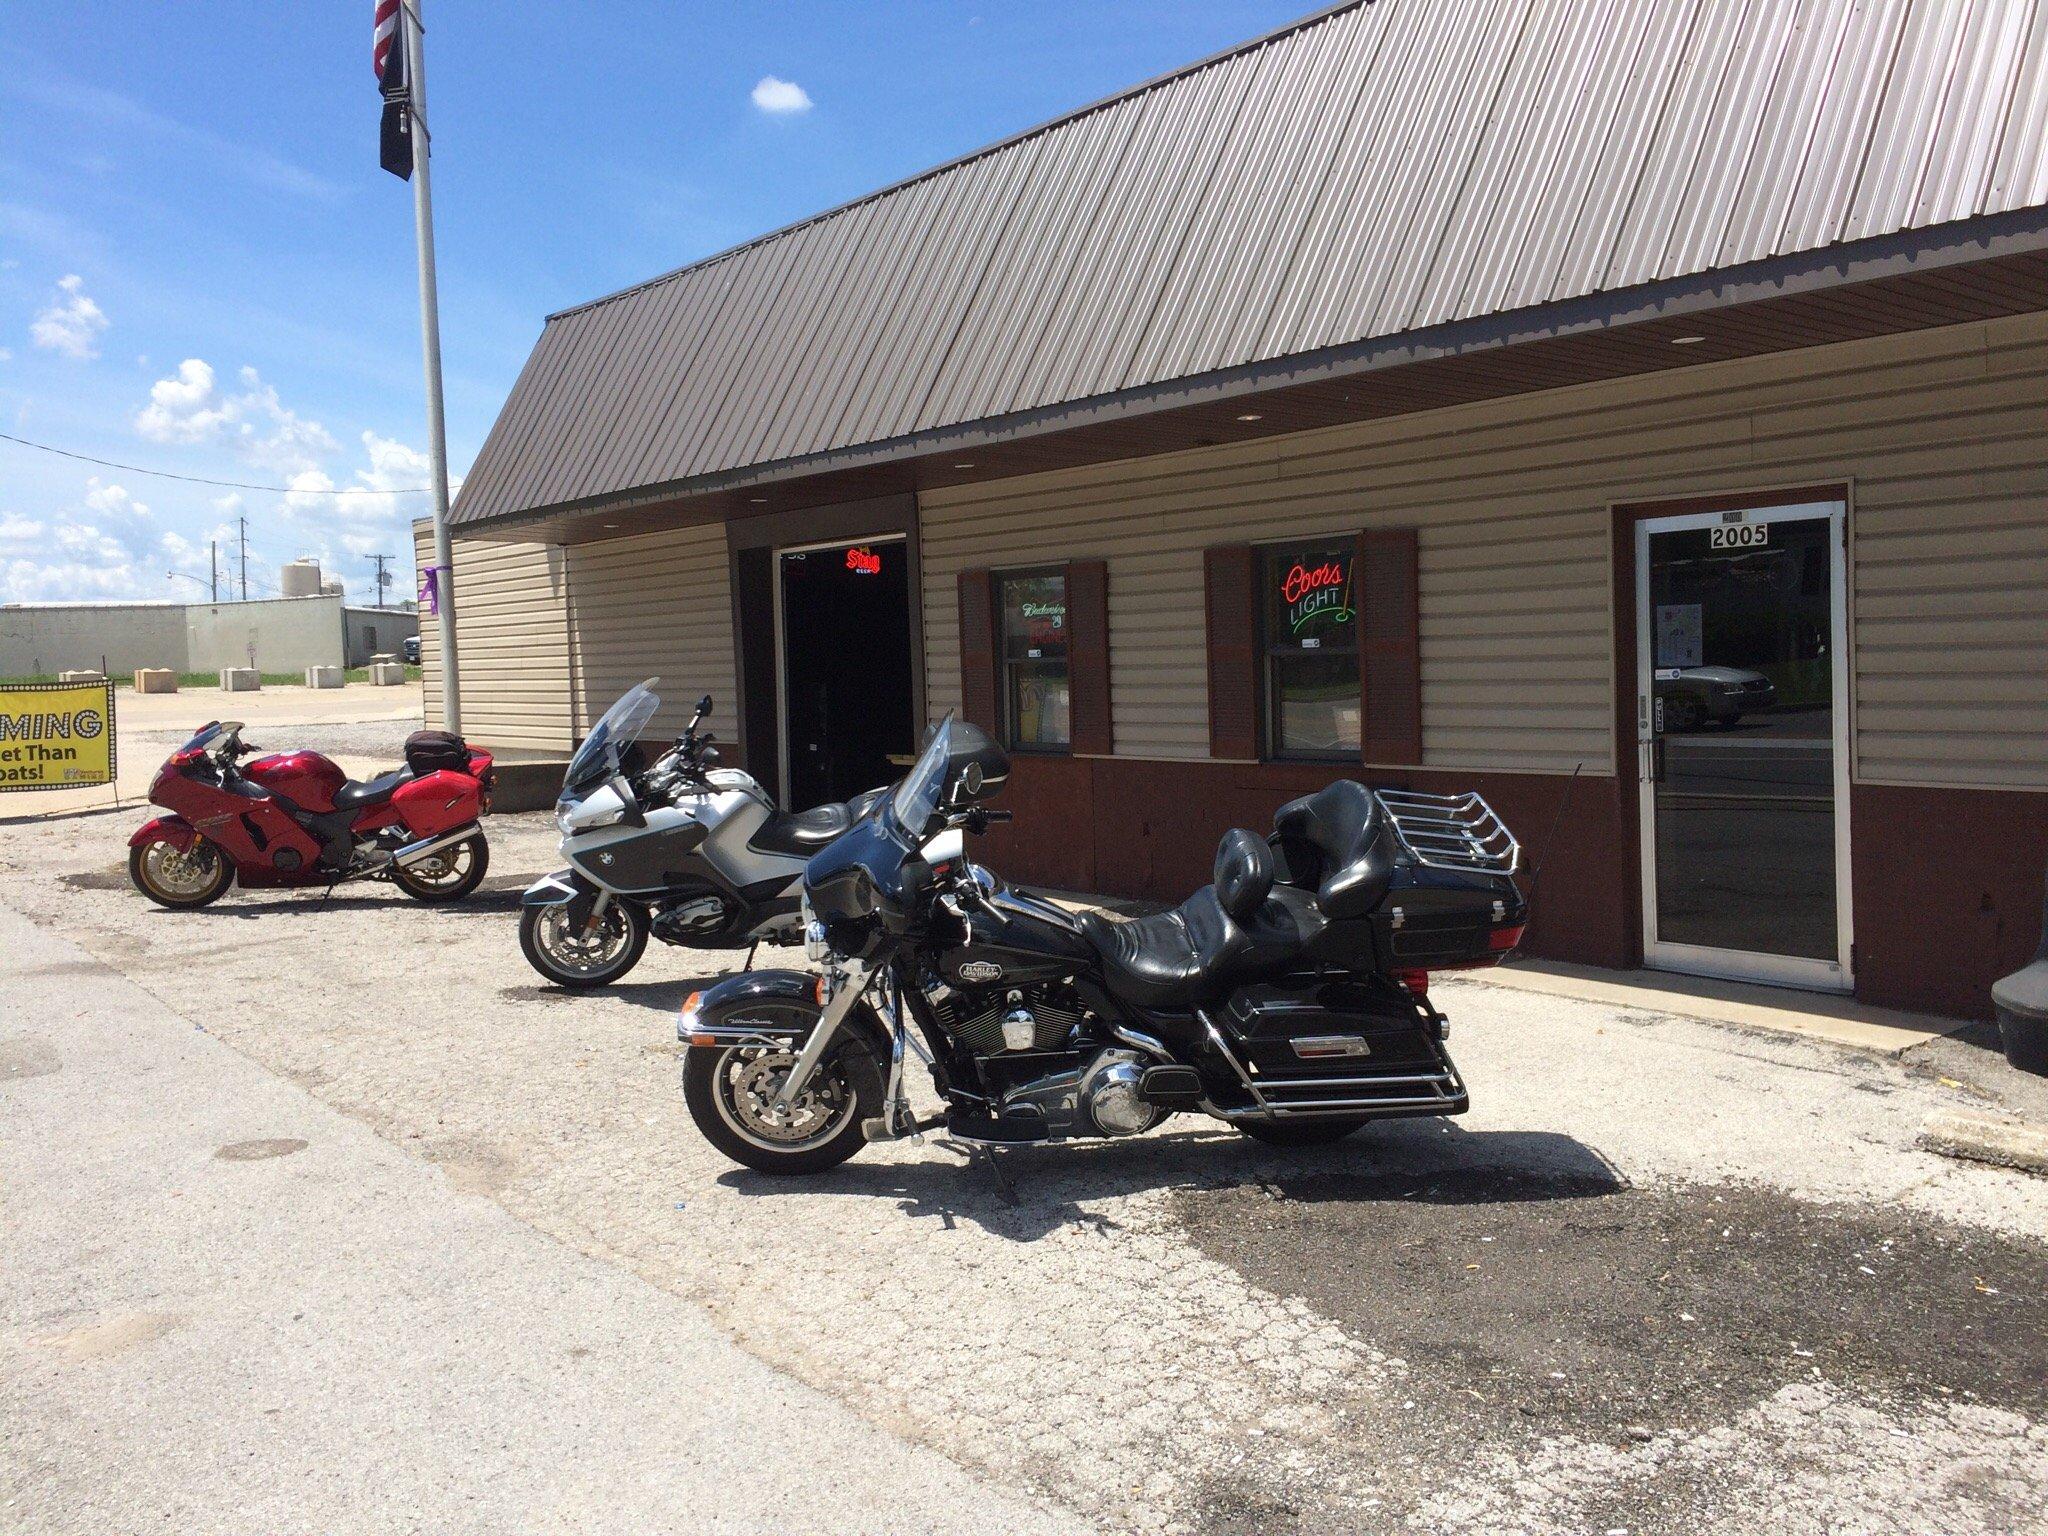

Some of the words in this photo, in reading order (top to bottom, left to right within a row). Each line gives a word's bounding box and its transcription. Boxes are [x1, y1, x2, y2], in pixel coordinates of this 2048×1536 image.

[1713, 525, 1766, 547] 2005
[846, 549, 880, 574] Stag
[1281, 563, 1342, 603] Coors
[1290, 588, 1339, 625] LIGHT
[0, 709, 103, 742] MING
[1, 747, 21, 762] et
[25, 744, 77, 761] Than
